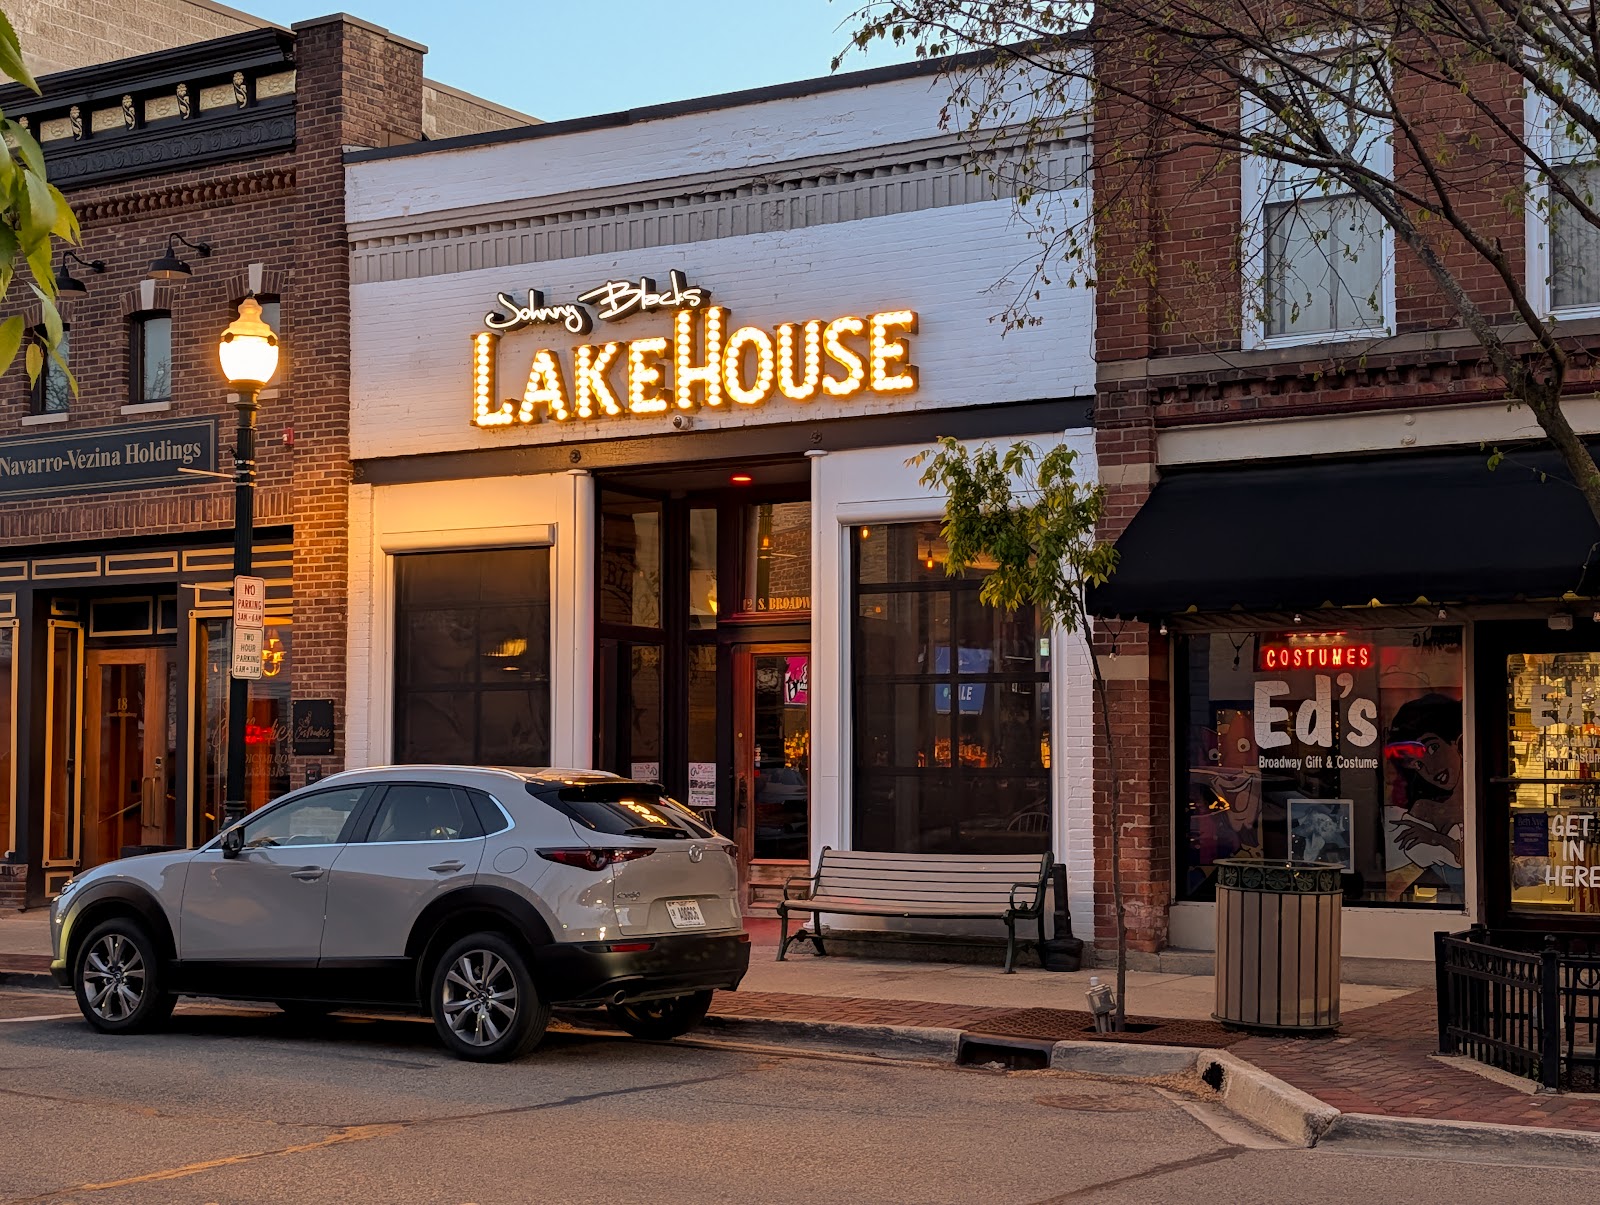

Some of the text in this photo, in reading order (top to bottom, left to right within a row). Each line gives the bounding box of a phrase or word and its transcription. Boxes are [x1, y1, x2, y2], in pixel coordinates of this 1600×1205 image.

[485, 270, 702, 335] Johnny Blacks
[0, 440, 201, 477] Navarro-Vezina Holdings
[244, 584, 256, 596] NO
[237, 599, 262, 610] PARKING
[243, 633, 255, 641] TWO
[240, 644, 257, 653] HOUR
[1266, 648, 1368, 667] COSTUMES
[236, 655, 260, 664] PARKING
[1254, 673, 1377, 749] Ed's
[1259, 755, 1378, 770] Broadway Gift & Costume
[1552, 814, 1594, 837] GET
[1562, 840, 1584, 862] IN
[1545, 865, 1600, 888] HERE
